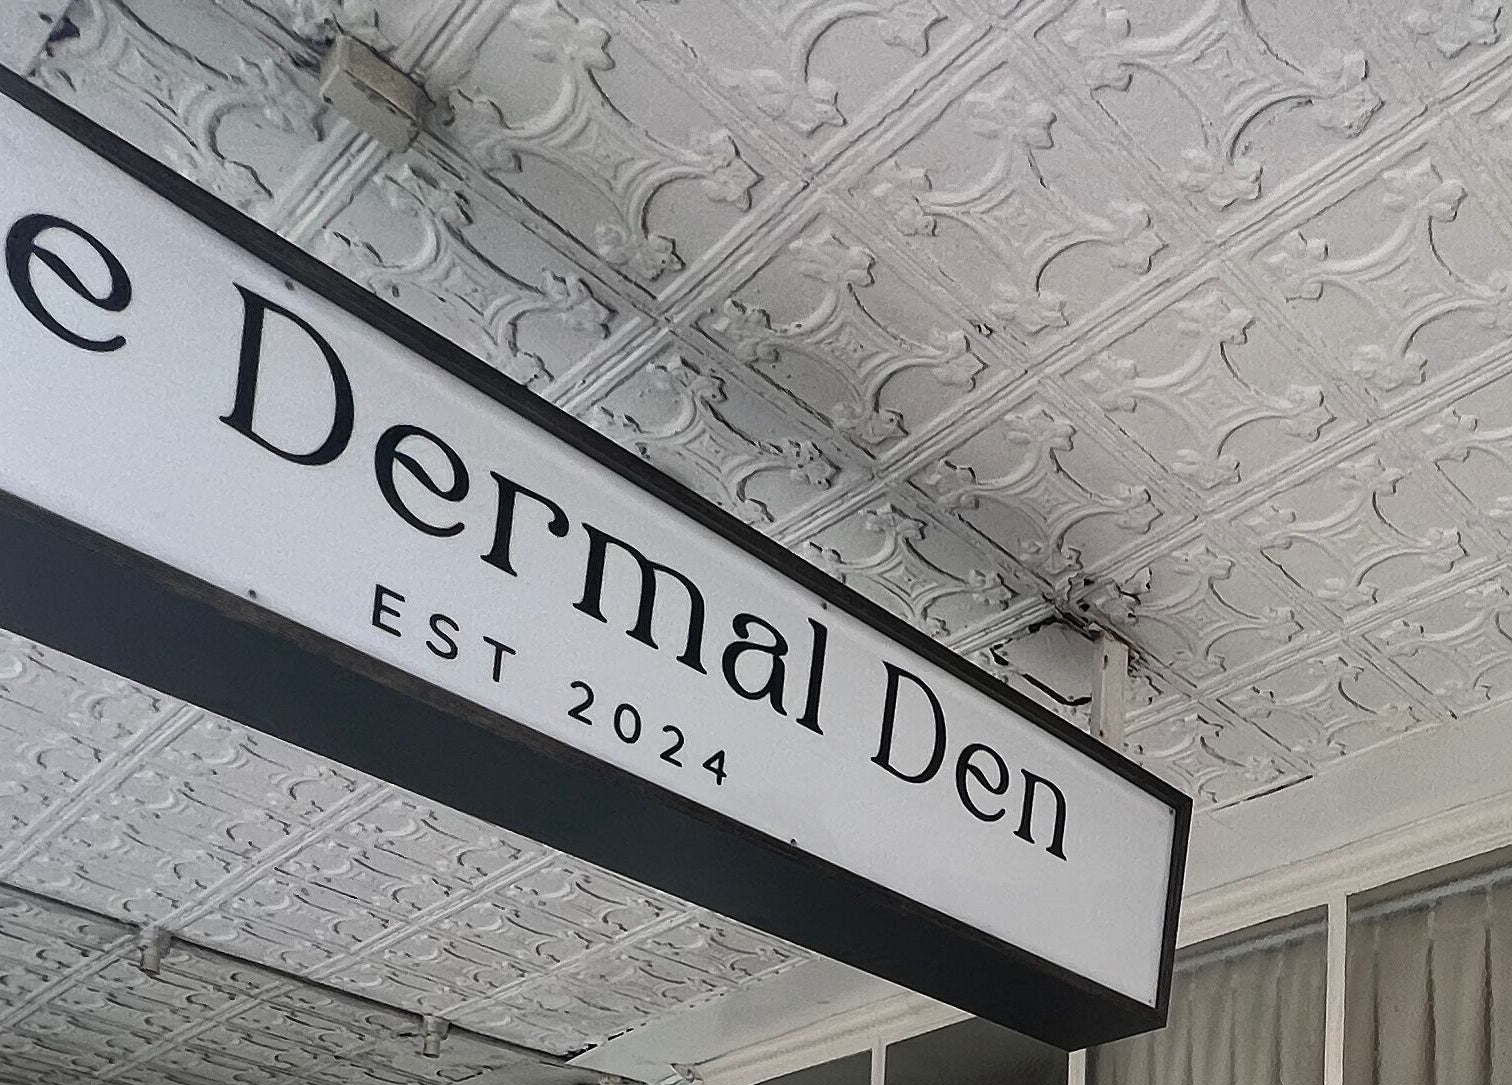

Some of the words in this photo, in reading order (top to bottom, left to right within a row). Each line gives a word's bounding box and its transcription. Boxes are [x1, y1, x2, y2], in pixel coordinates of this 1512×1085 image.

[218, 281, 828, 736] Dermal
[870, 659, 1069, 861] Den
[371, 583, 516, 683] EST
[567, 680, 728, 787] 2024
